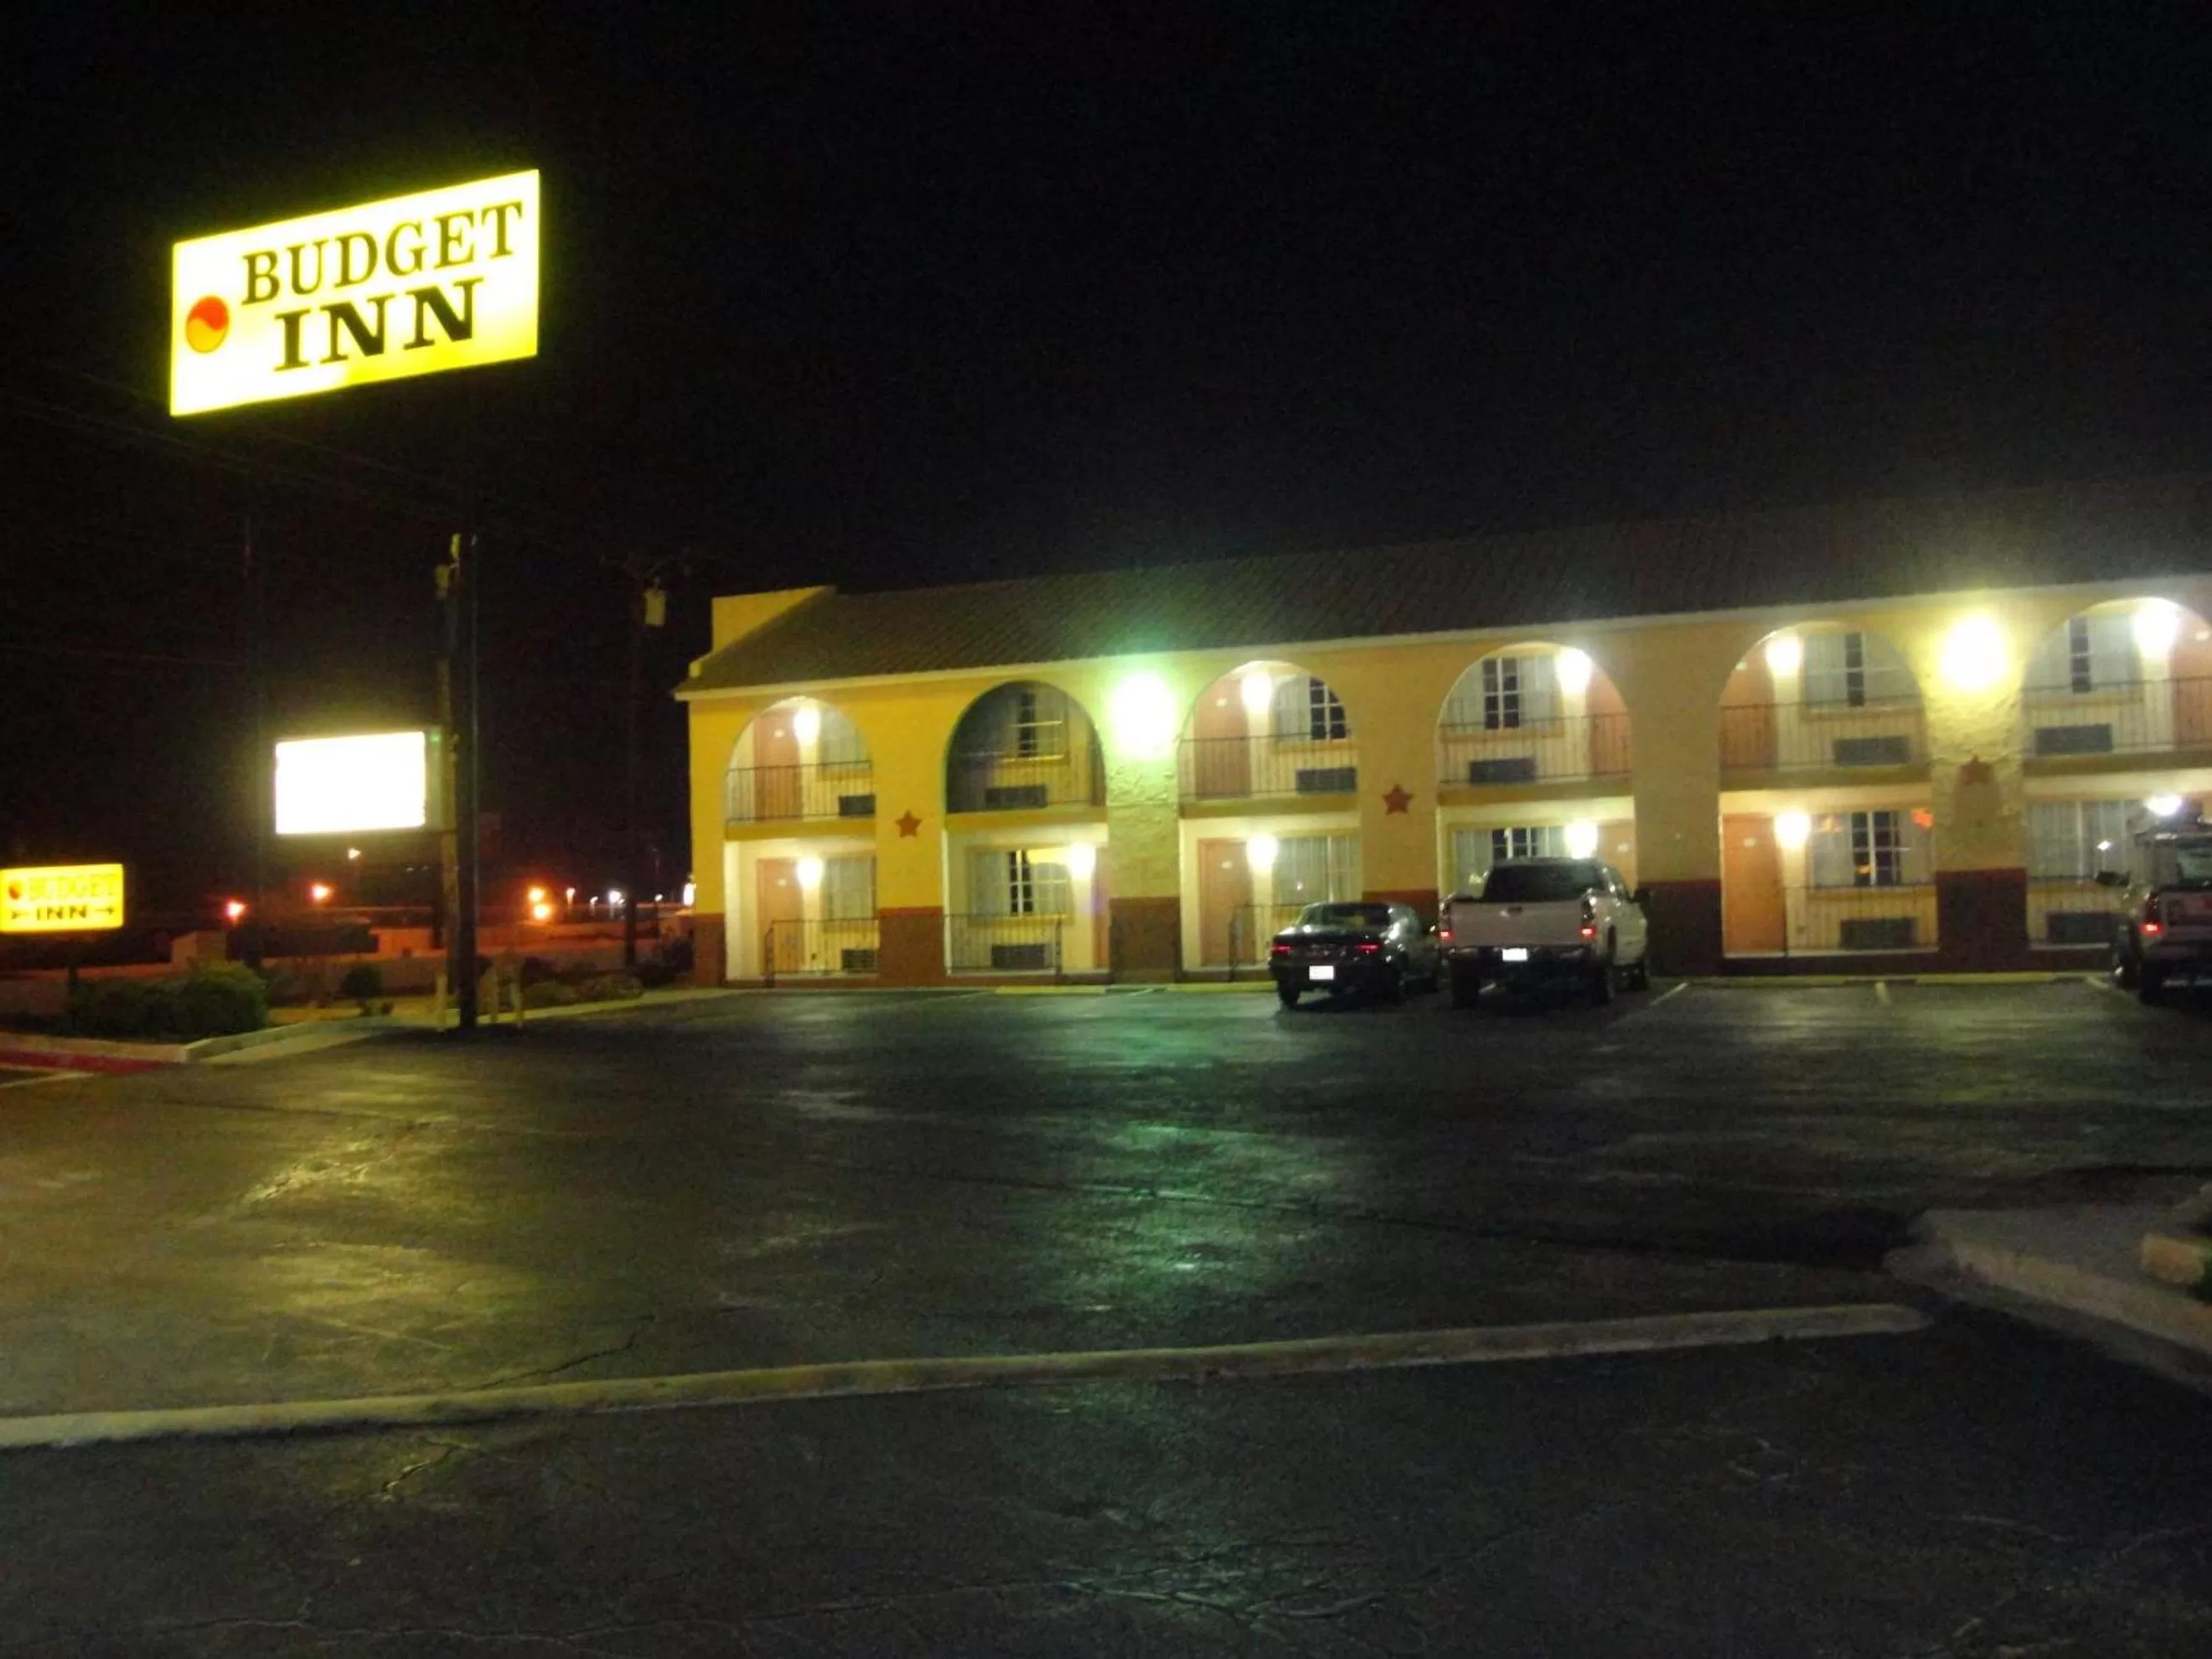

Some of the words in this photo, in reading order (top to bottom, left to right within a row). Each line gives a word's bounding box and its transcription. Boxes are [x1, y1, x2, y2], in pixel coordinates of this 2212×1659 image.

[241, 200, 524, 306] BUDGET
[273, 276, 484, 372] INN
[36, 904, 88, 921] INN
